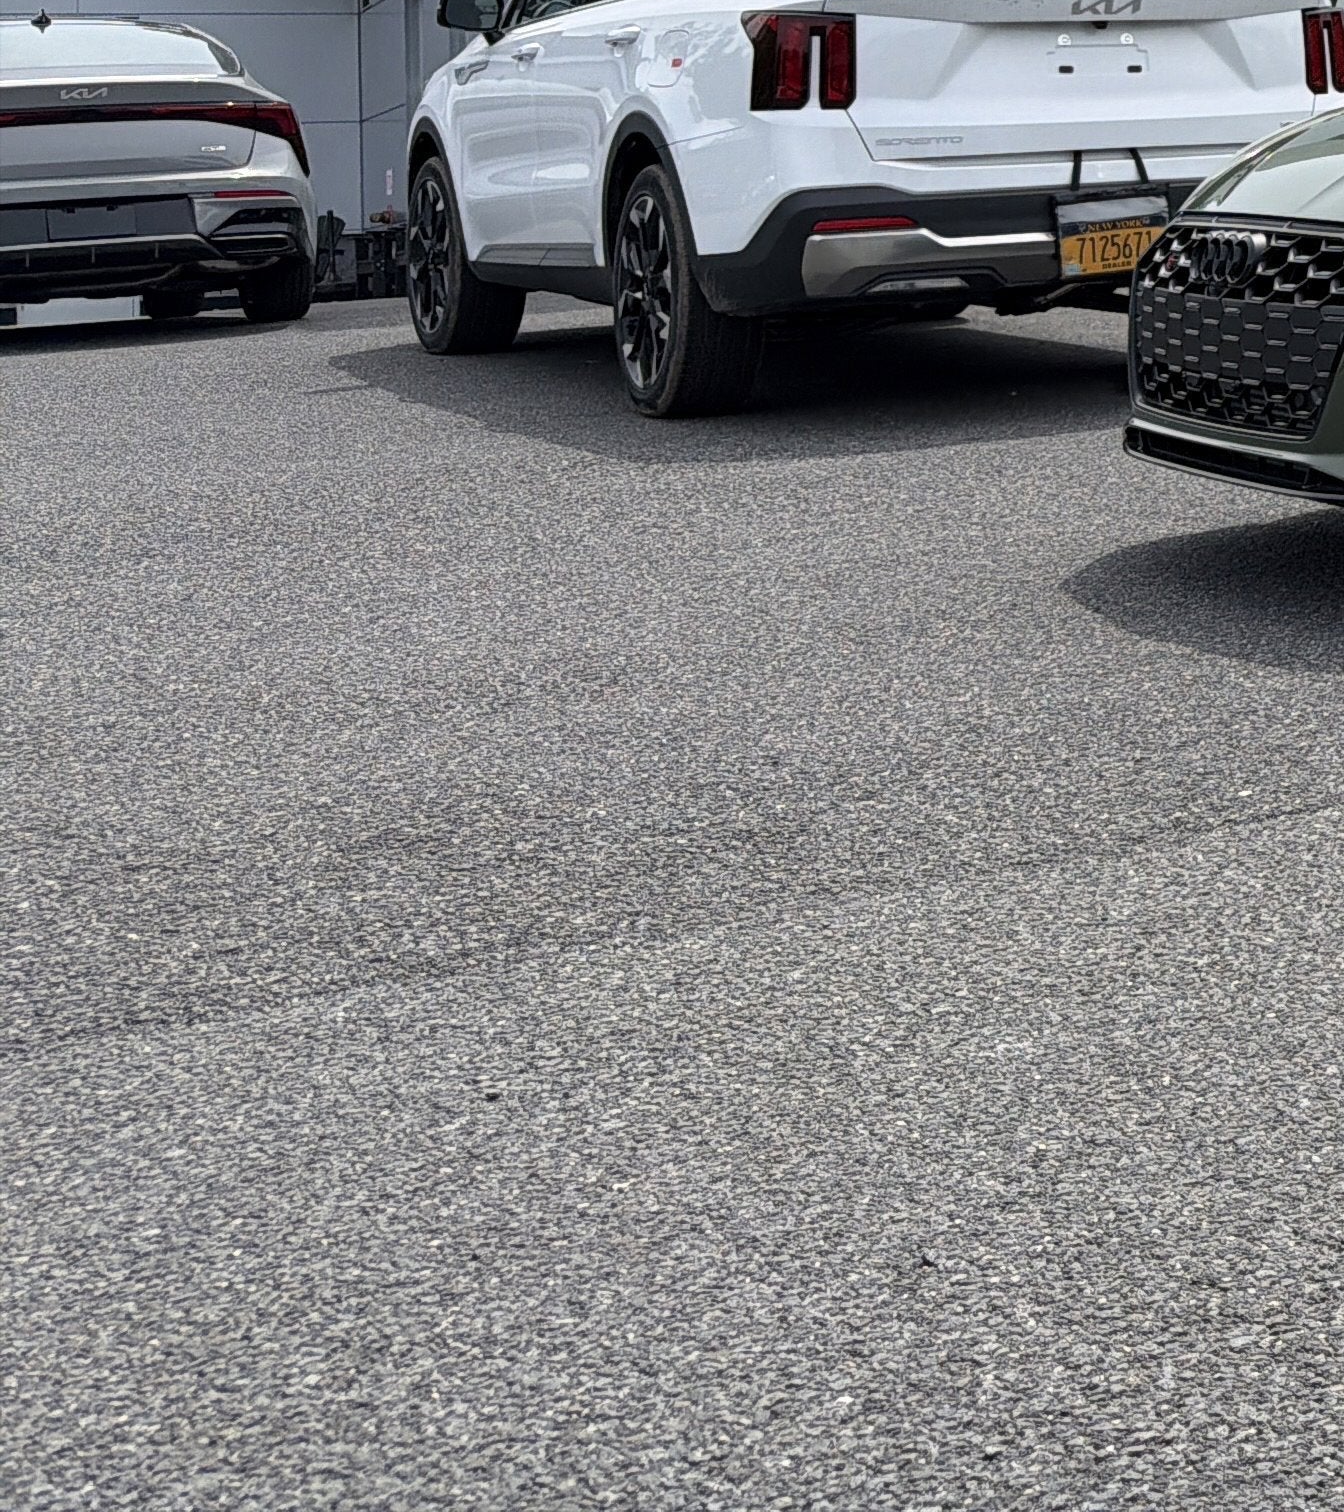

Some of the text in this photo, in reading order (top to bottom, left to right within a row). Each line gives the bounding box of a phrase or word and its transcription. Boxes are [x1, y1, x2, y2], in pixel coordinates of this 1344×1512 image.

[1071, 0, 1142, 16] KIA
[60, 87, 108, 100] KIA
[875, 135, 964, 146] SORENTO
[1087, 219, 1143, 233] NEW YORK
[1102, 260, 1132, 270] DEALER
